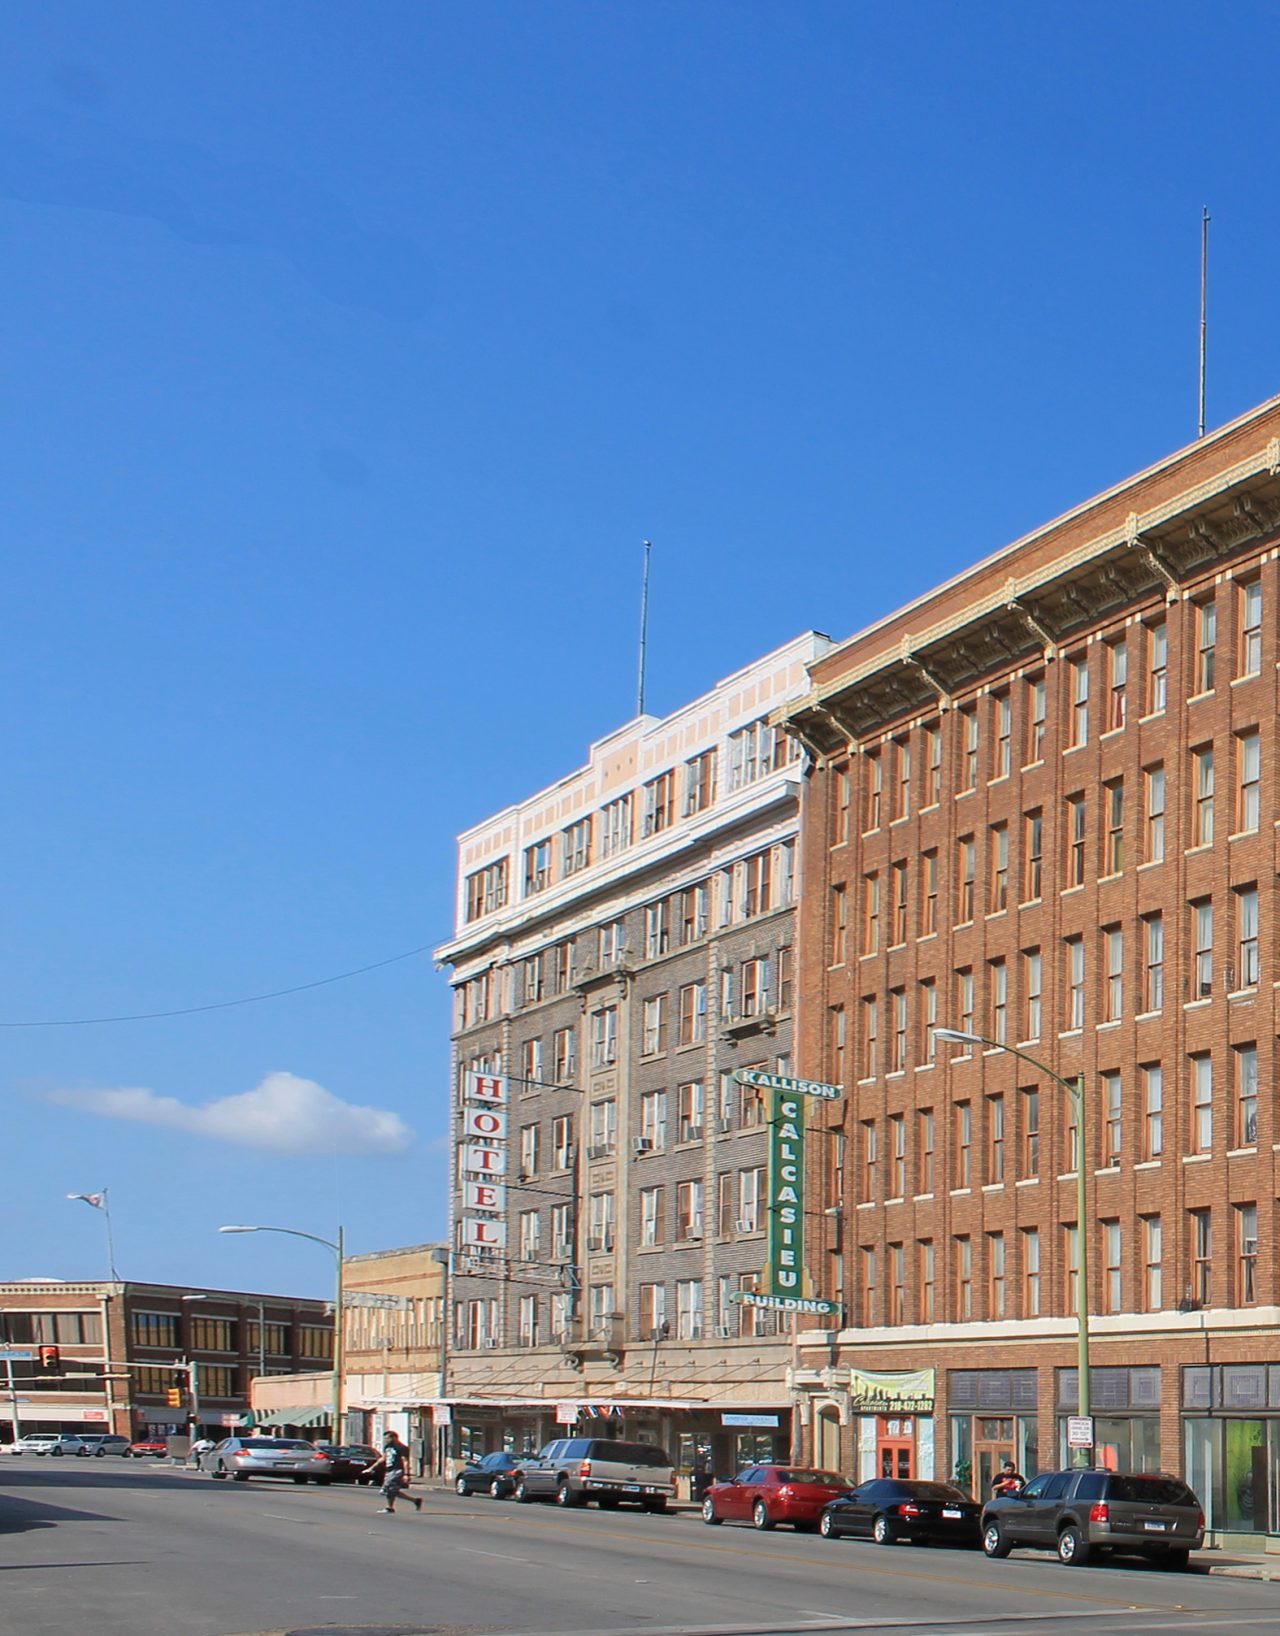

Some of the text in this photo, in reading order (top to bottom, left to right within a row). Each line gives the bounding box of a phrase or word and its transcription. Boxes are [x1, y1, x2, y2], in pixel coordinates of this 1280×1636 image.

[742, 1071, 836, 1098] KALLISON
[473, 1076, 502, 1244] HOTEL
[777, 1101, 800, 1288] CALCASIEU
[743, 1294, 831, 1314] BUILDING
